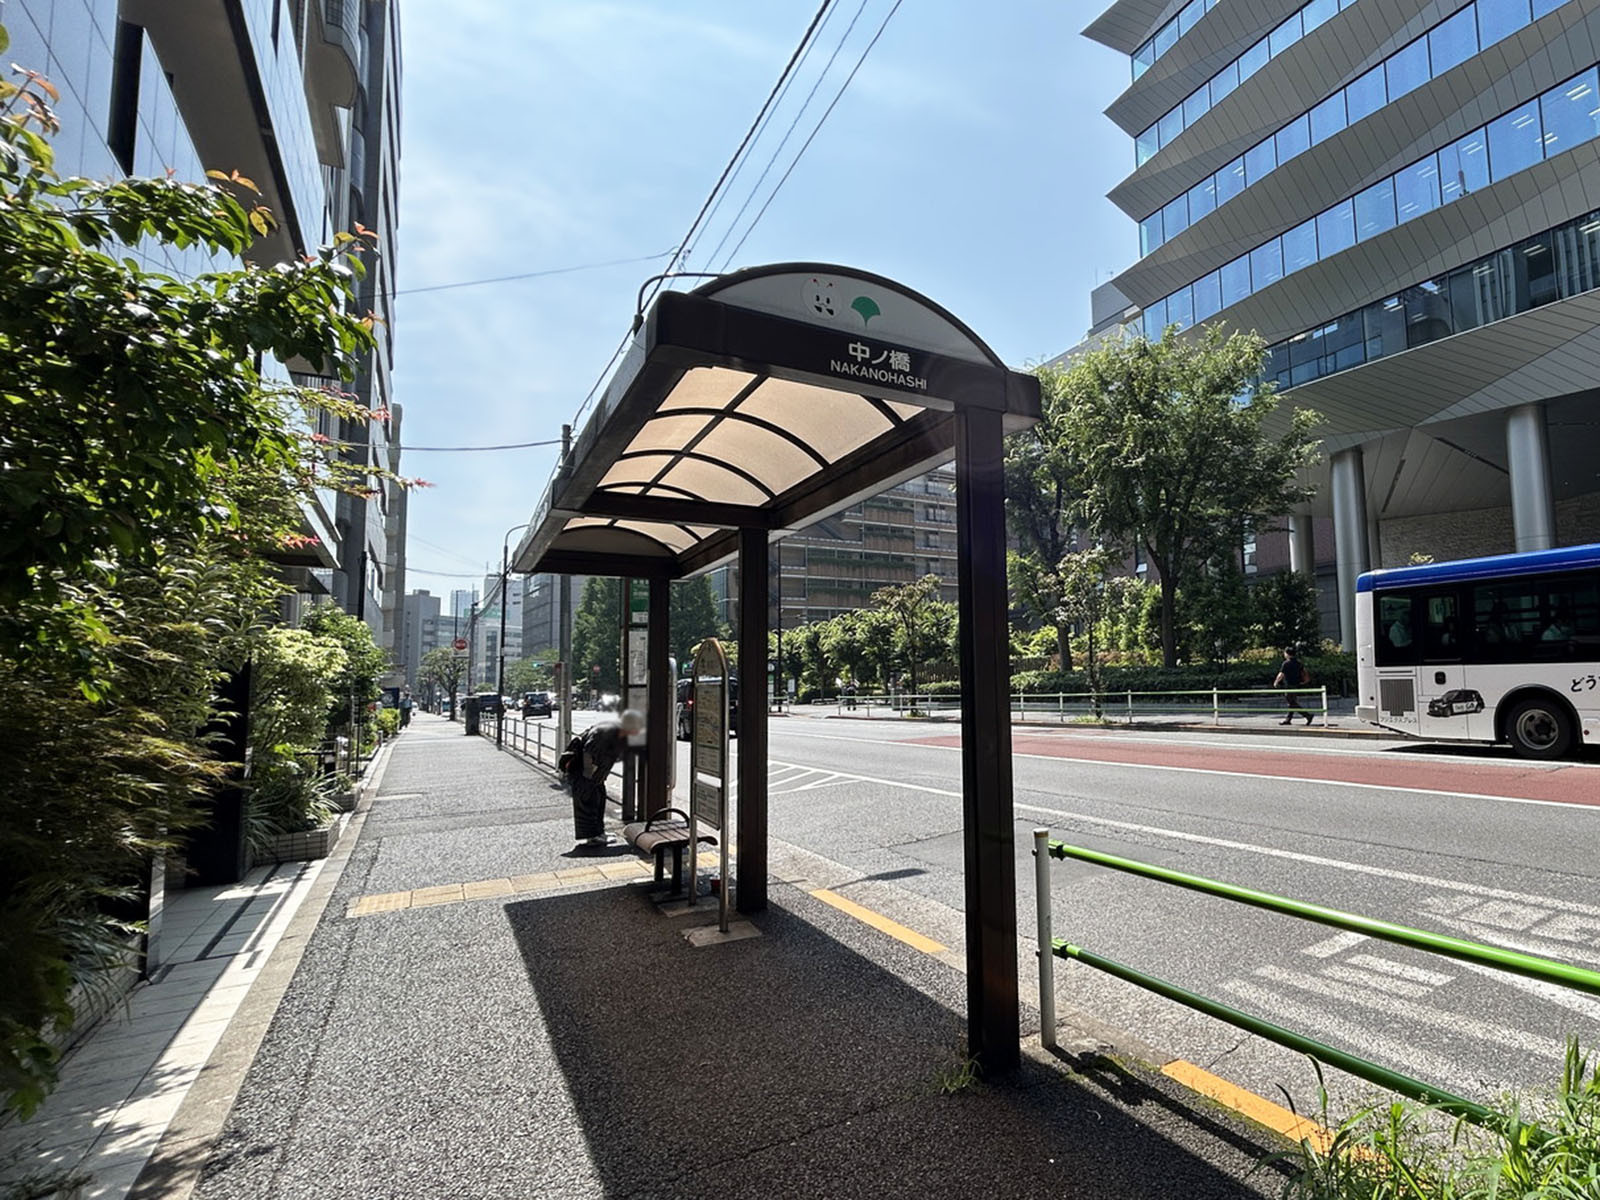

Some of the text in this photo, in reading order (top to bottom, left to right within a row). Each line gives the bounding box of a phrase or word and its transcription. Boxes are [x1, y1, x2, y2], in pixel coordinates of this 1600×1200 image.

[848, 341, 911, 372] 中ノ橋
[830, 359, 928, 390] NAKANOHASHI
[1571, 675, 1600, 693] どう
